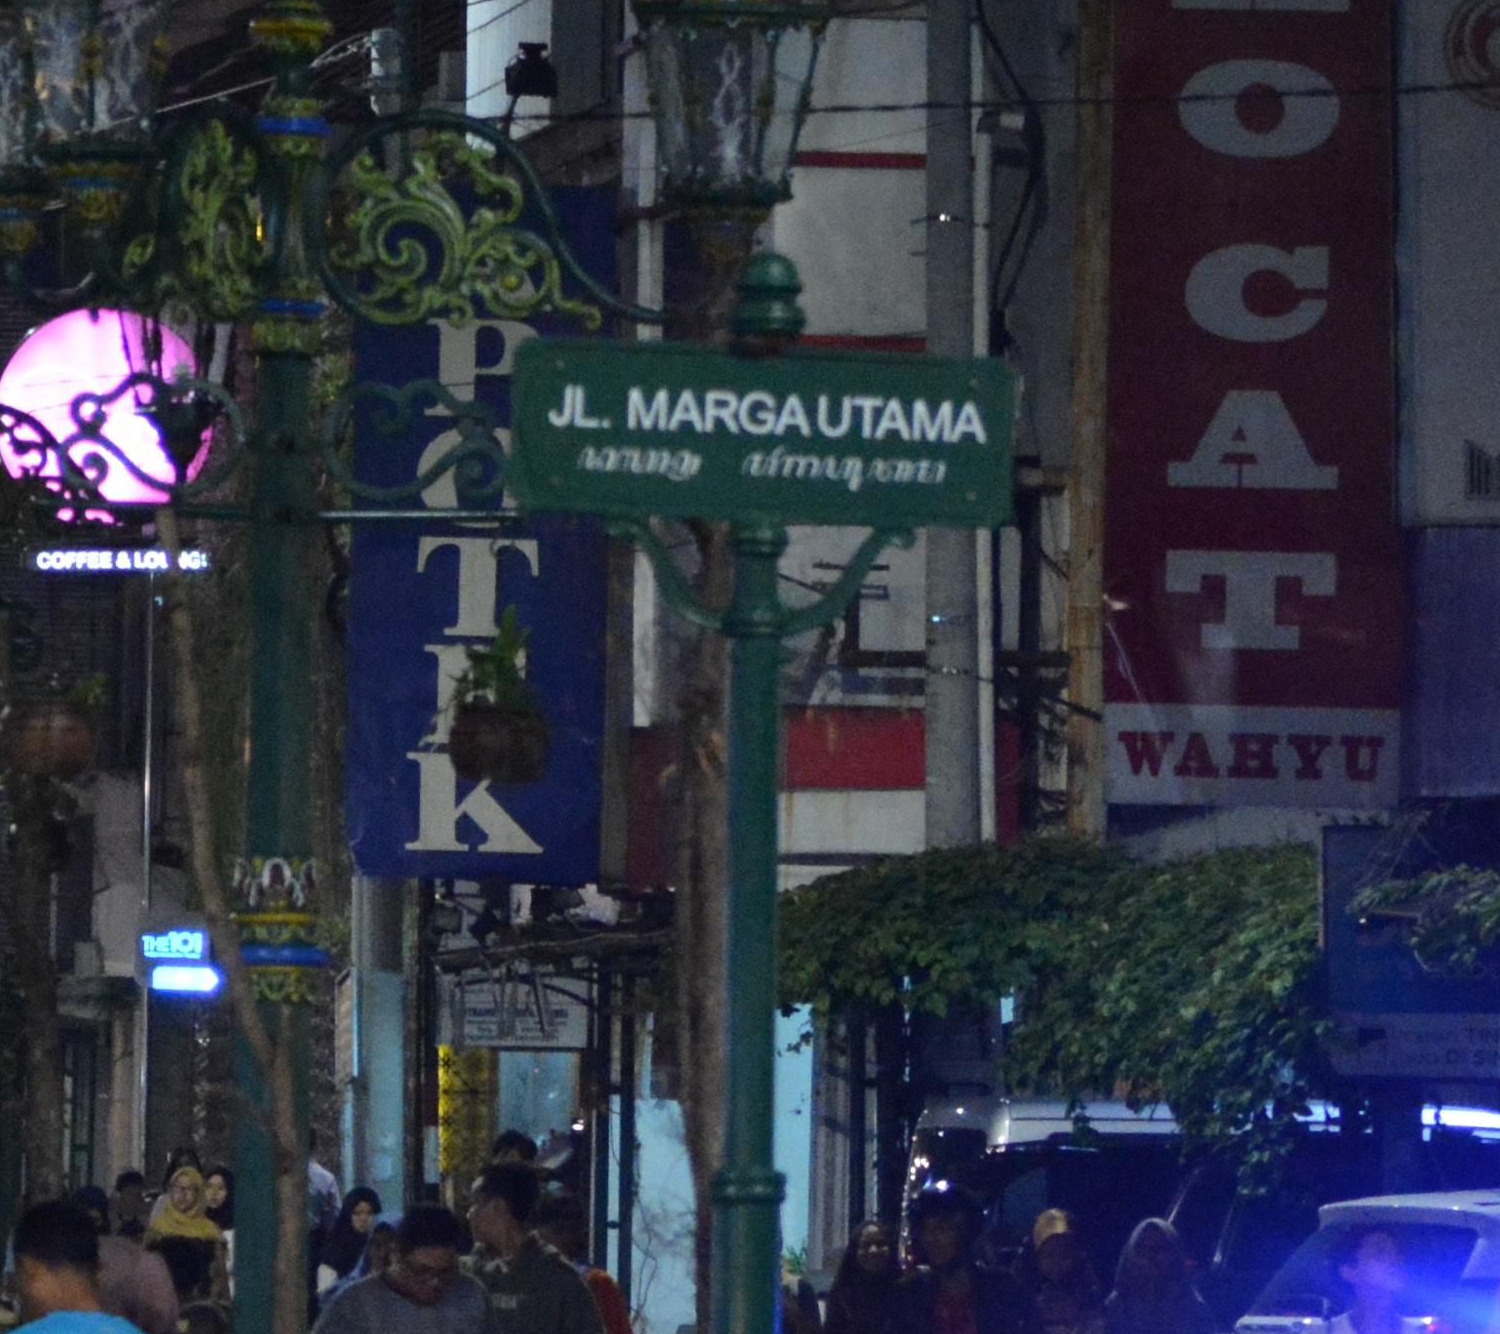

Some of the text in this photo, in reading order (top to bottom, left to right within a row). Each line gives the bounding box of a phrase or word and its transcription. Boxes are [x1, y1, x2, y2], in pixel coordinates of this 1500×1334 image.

[548, 383, 988, 444] JL. MARGA UTAMA
[1165, 242, 1339, 651] CAT
[35, 549, 113, 571] COFFEE
[115, 550, 131, 570] &
[1118, 729, 1388, 780] WAHYU
